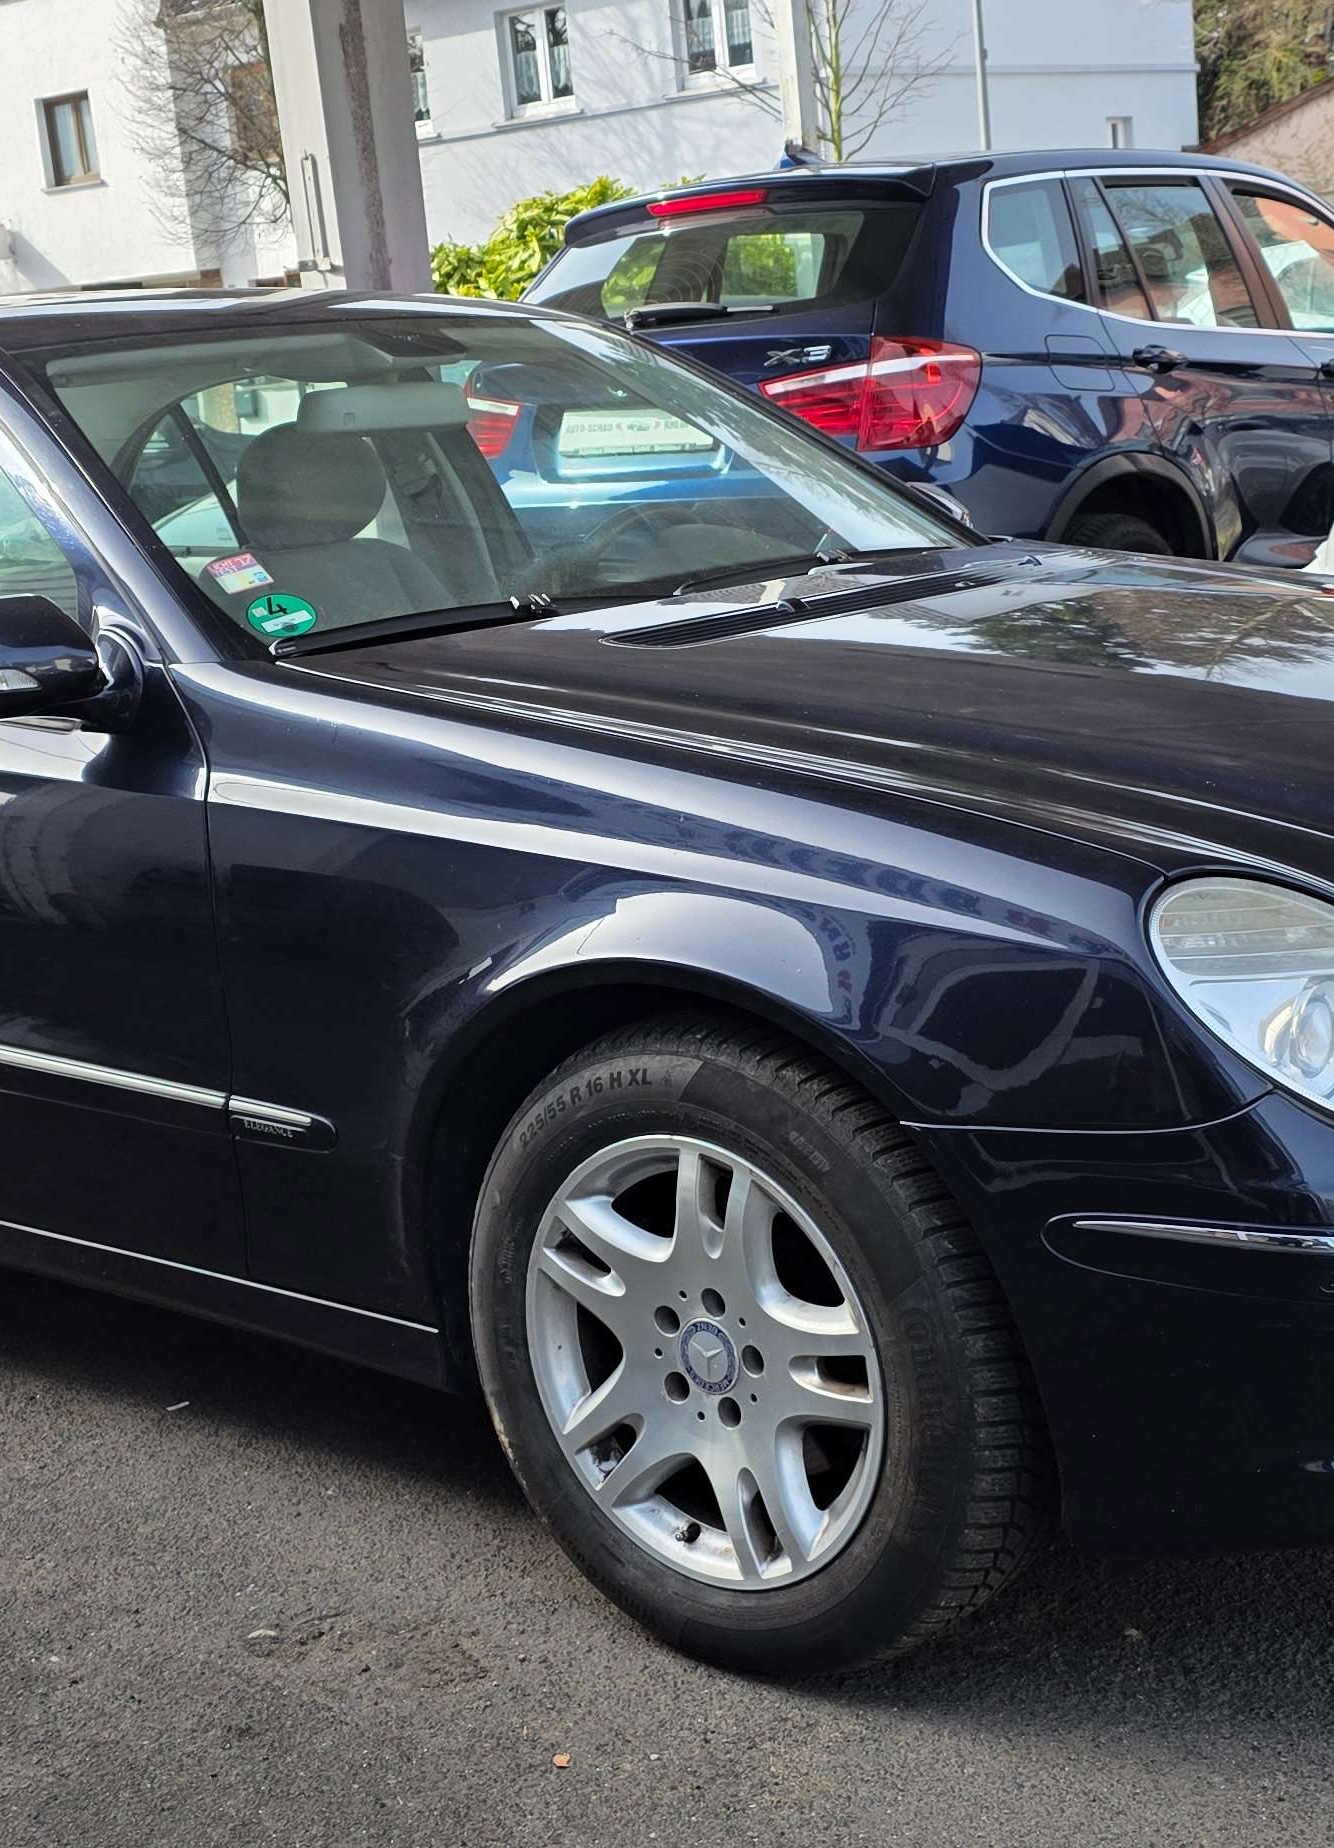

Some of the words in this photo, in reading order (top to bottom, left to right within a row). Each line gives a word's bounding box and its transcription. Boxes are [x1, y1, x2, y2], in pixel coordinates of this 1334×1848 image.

[763, 345, 831, 367] X3
[266, 597, 287, 615] 4
[519, 1094, 566, 1147] 225/55
[569, 1086, 582, 1105] R
[585, 1077, 604, 1097] 16
[609, 1071, 622, 1090] H
[628, 1068, 652, 1087] XL
[244, 1119, 294, 1138] ELEGANCE
